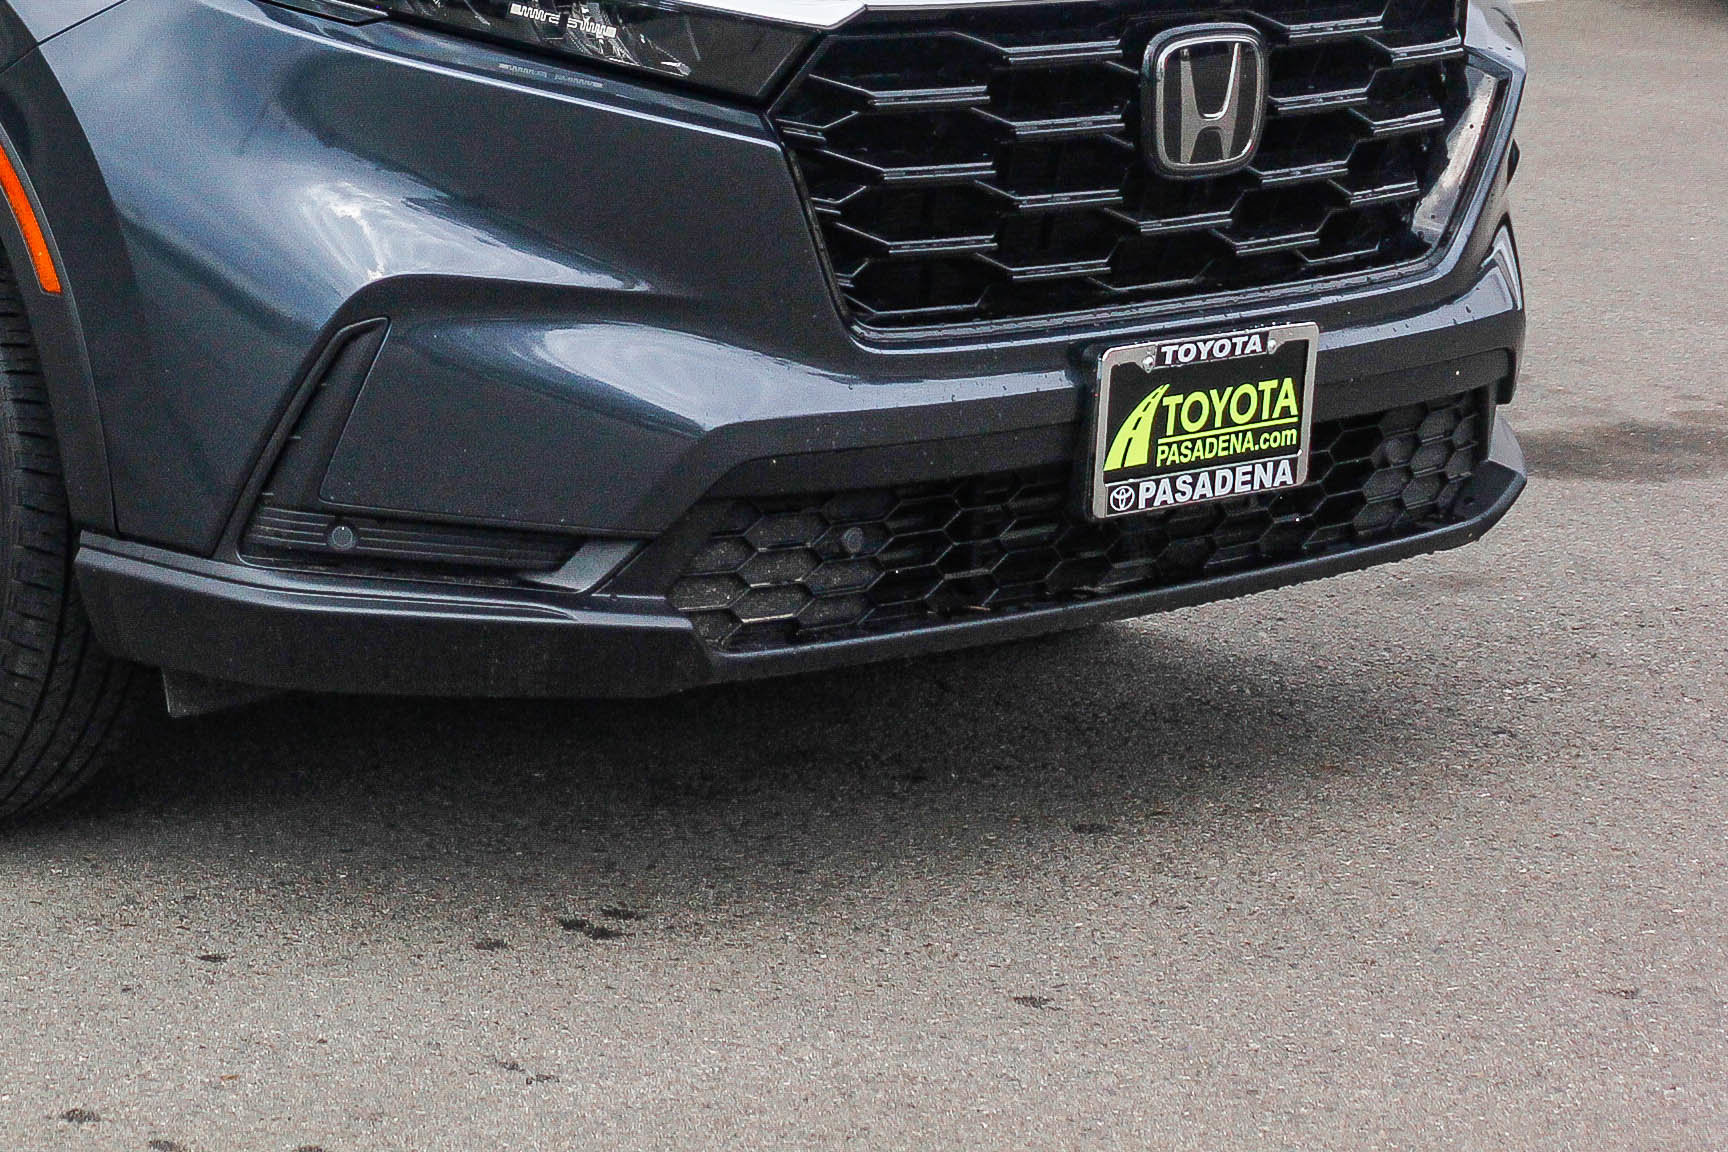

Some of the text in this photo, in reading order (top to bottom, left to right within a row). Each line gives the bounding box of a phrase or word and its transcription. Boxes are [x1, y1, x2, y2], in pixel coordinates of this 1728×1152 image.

[1161, 334, 1263, 365] TOYOTA
[1162, 377, 1299, 436] TOYOTA
[1156, 428, 1297, 467] PASADENA.com
[1138, 459, 1294, 509] PASADENA
